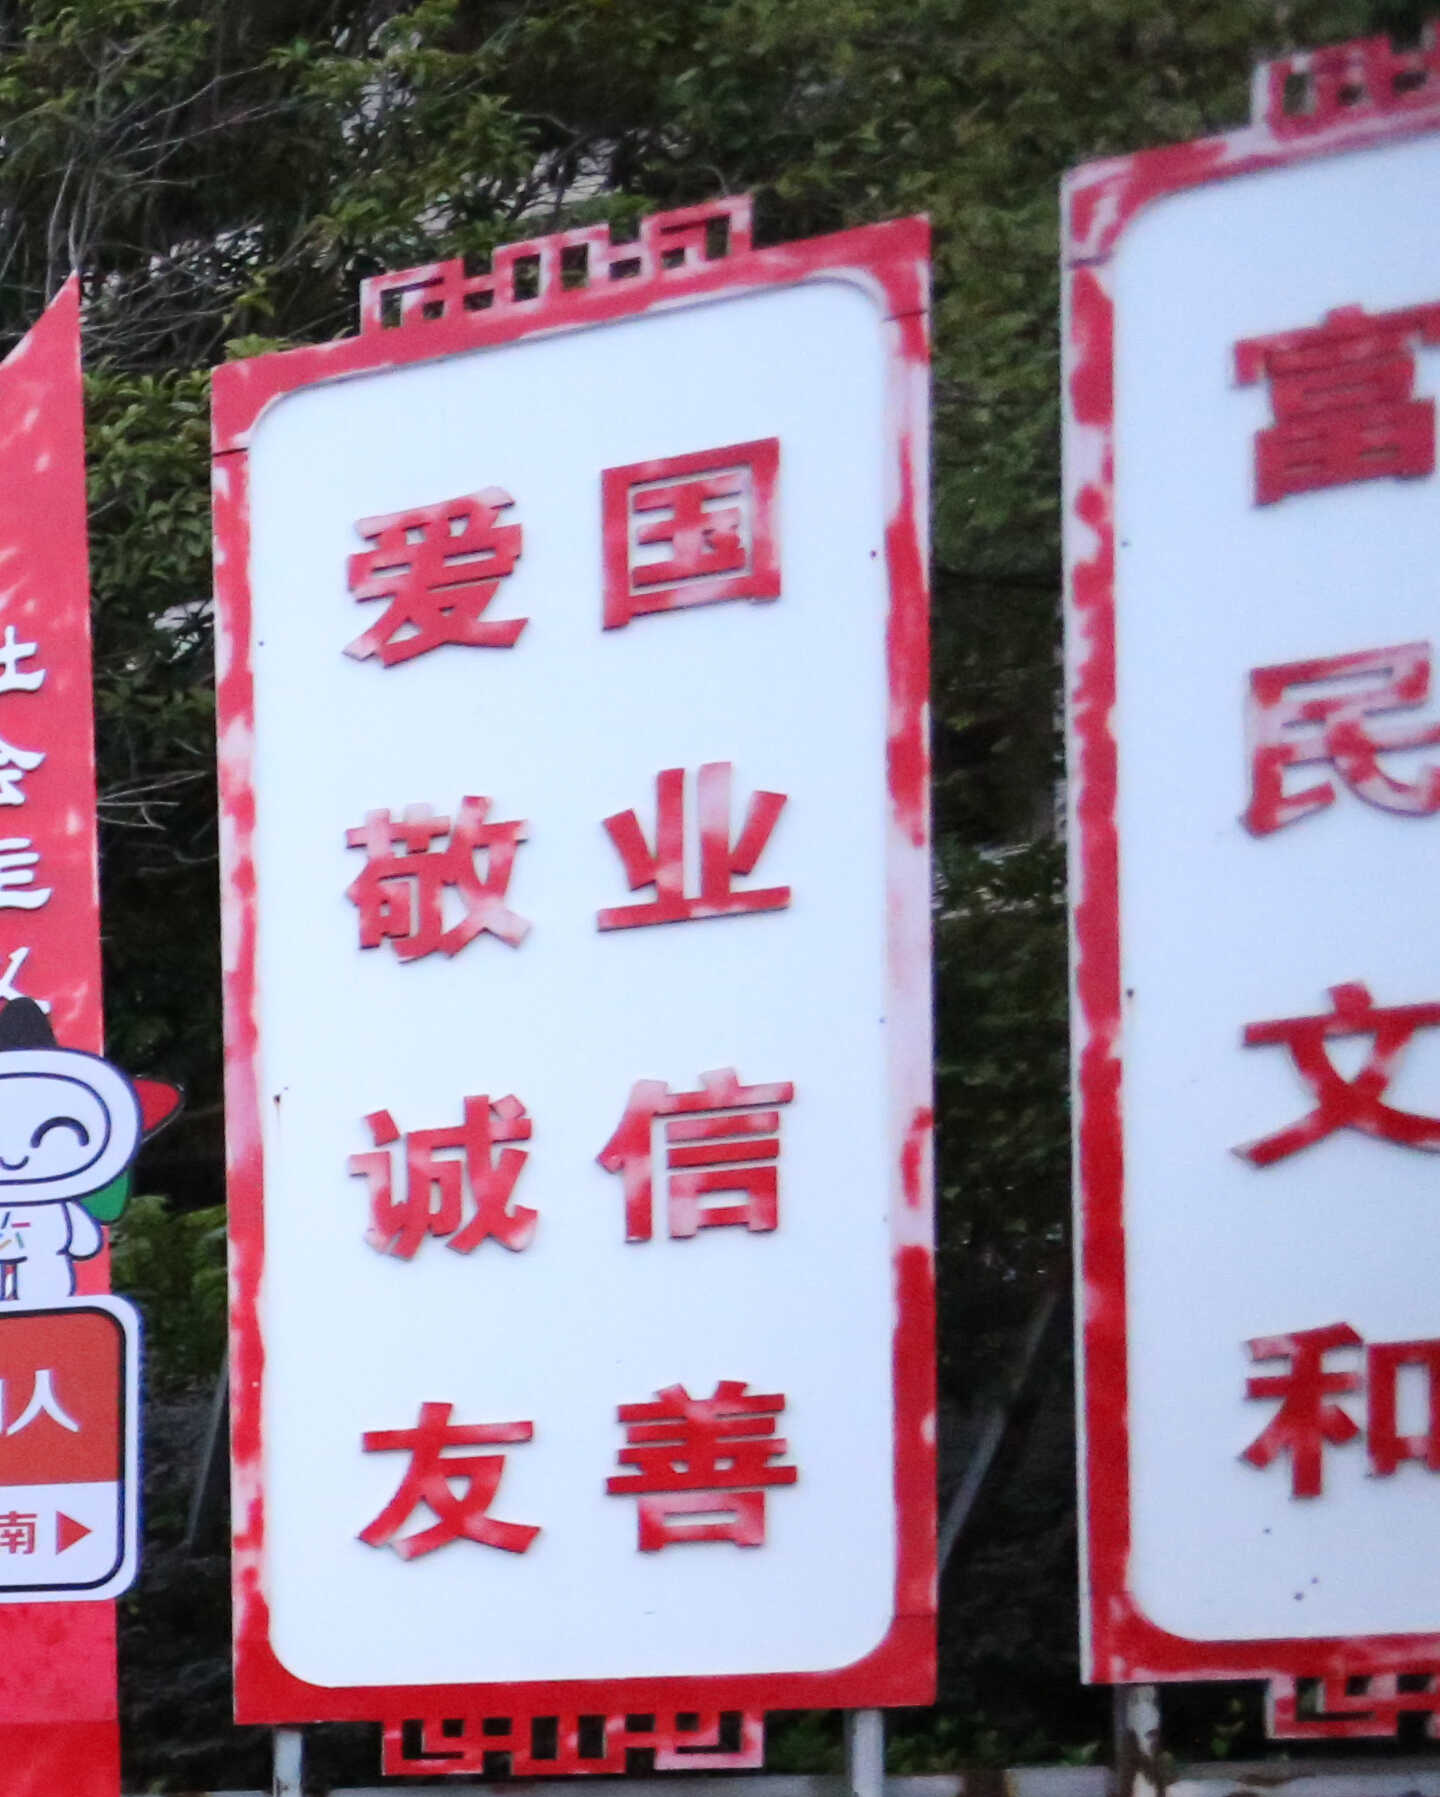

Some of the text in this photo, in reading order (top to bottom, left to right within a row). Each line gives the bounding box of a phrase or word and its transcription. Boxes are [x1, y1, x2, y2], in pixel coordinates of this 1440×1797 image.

[343, 437, 781, 668] 爱国
[344, 762, 791, 964] 敬业
[349, 1068, 794, 1261] 诚信
[356, 1380, 797, 1560] 友善
